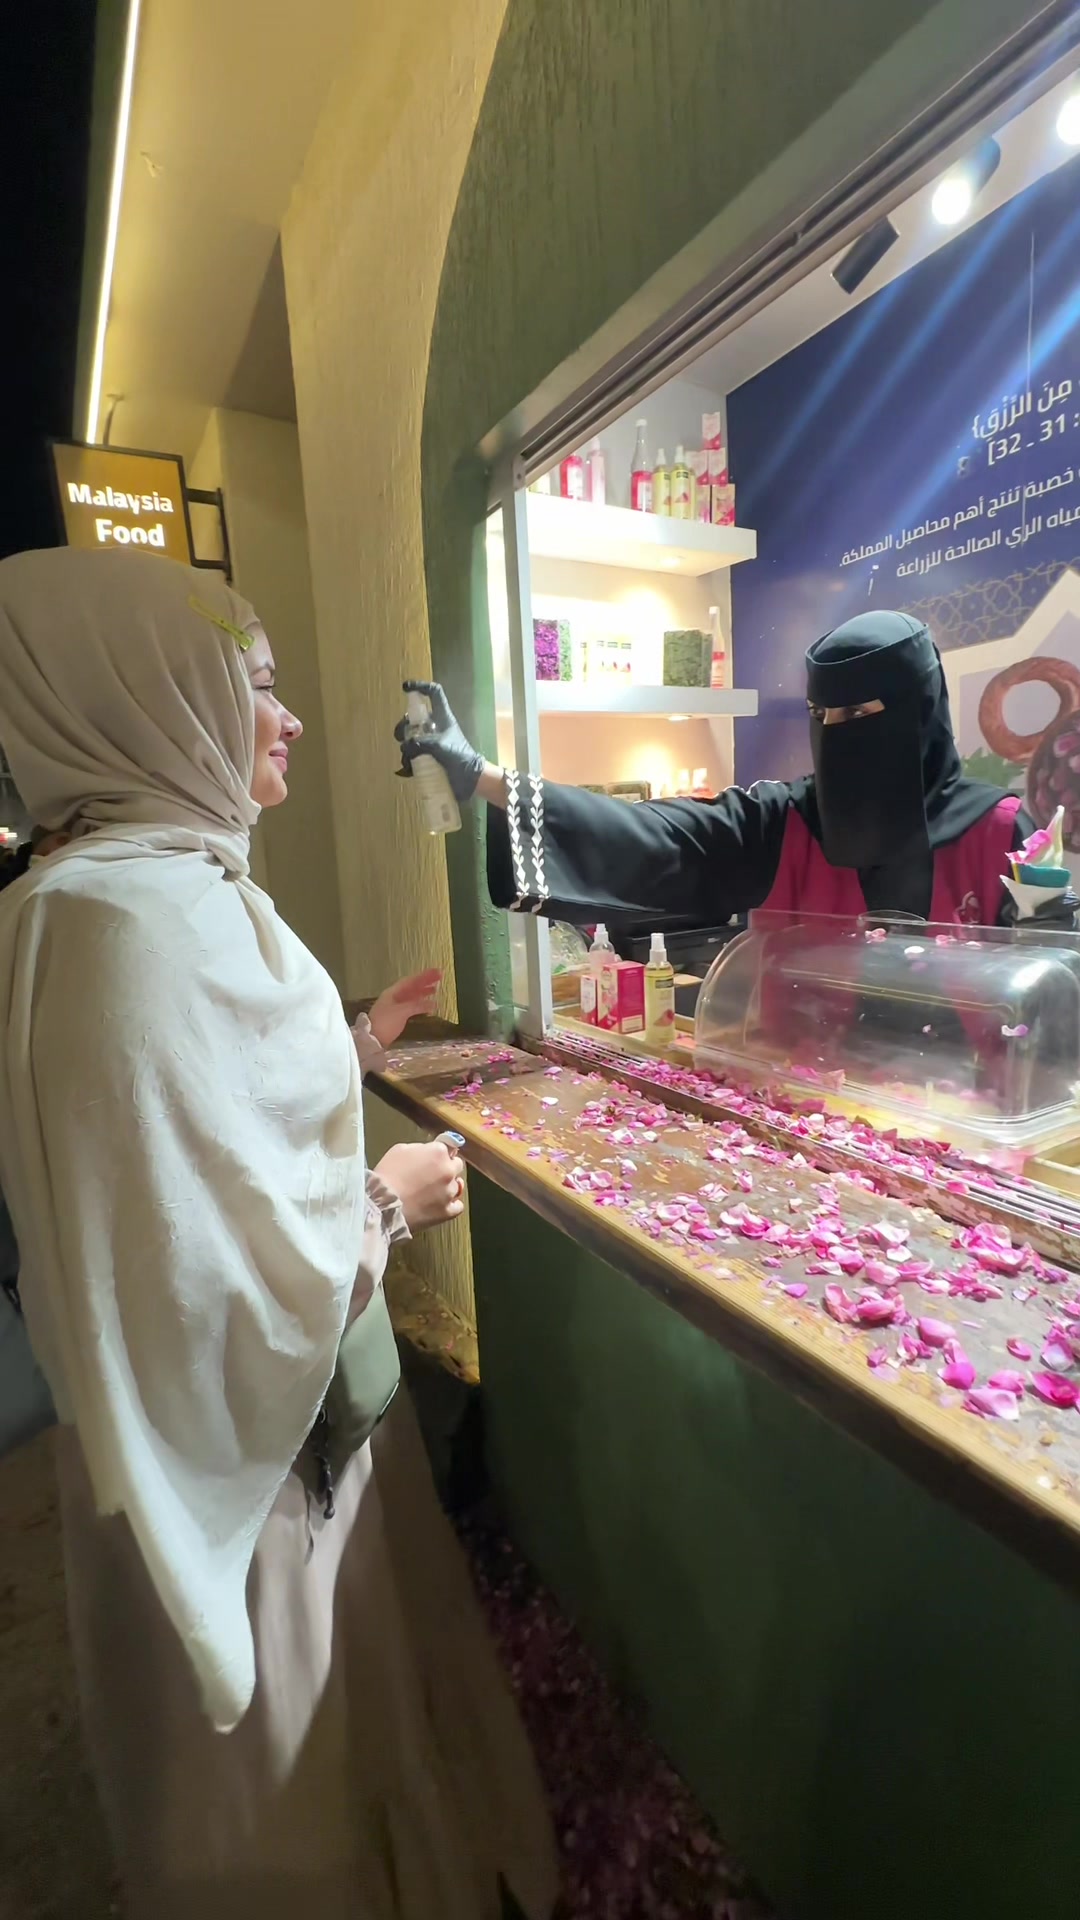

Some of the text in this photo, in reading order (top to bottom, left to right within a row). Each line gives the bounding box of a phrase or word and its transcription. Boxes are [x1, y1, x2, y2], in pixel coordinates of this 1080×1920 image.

[1039, 413, 1065, 442] 31
[67, 482, 174, 515] Malaysia
[1025, 467, 1074, 498] خصبة
[953, 496, 984, 530] أهم
[987, 486, 1021, 518] تنتج
[95, 518, 166, 547] Food
[895, 516, 950, 550] محاصيل
[945, 529, 1001, 561] الصالحة
[1005, 516, 1042, 548] الري
[897, 550, 941, 577] للزراعة
